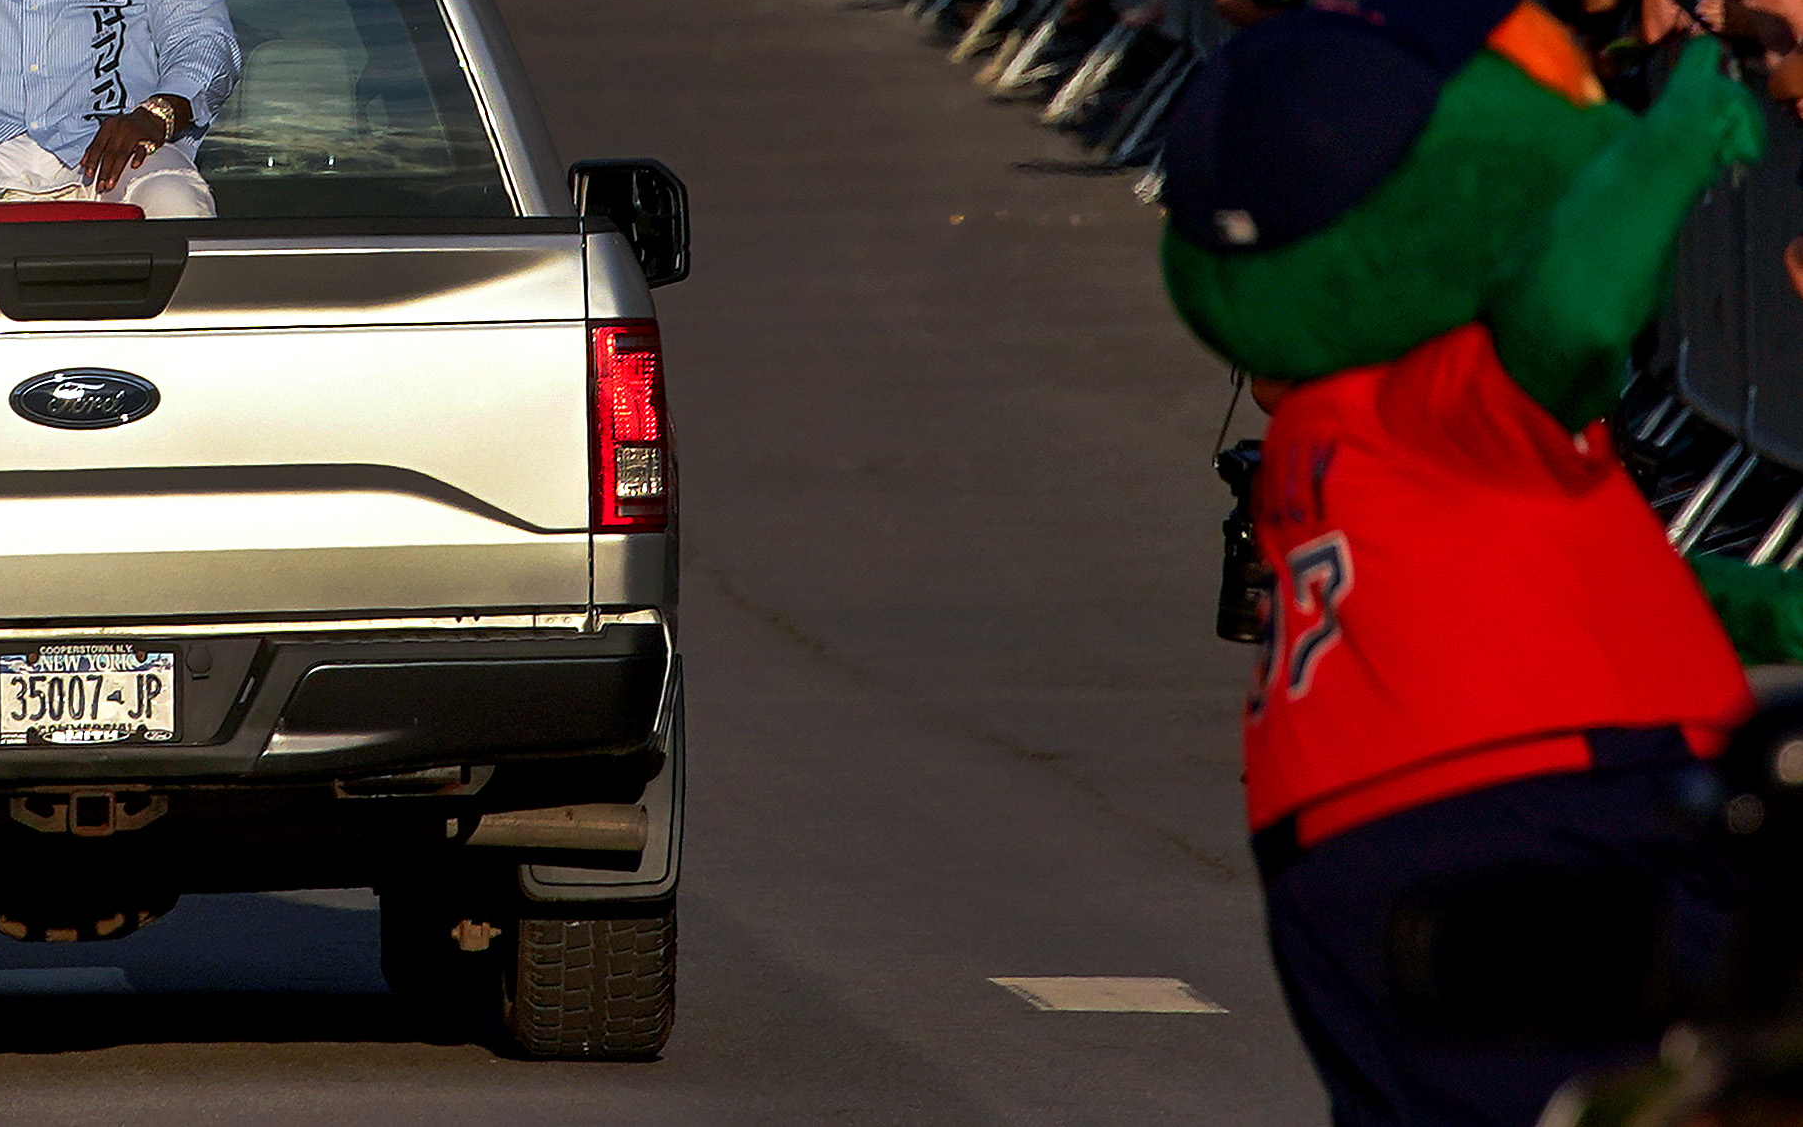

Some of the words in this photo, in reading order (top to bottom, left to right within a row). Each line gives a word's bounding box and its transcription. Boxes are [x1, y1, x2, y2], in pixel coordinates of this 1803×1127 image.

[48, 381, 126, 415] Ford
[37, 654, 82, 672] NEW
[86, 653, 136, 672] YORK
